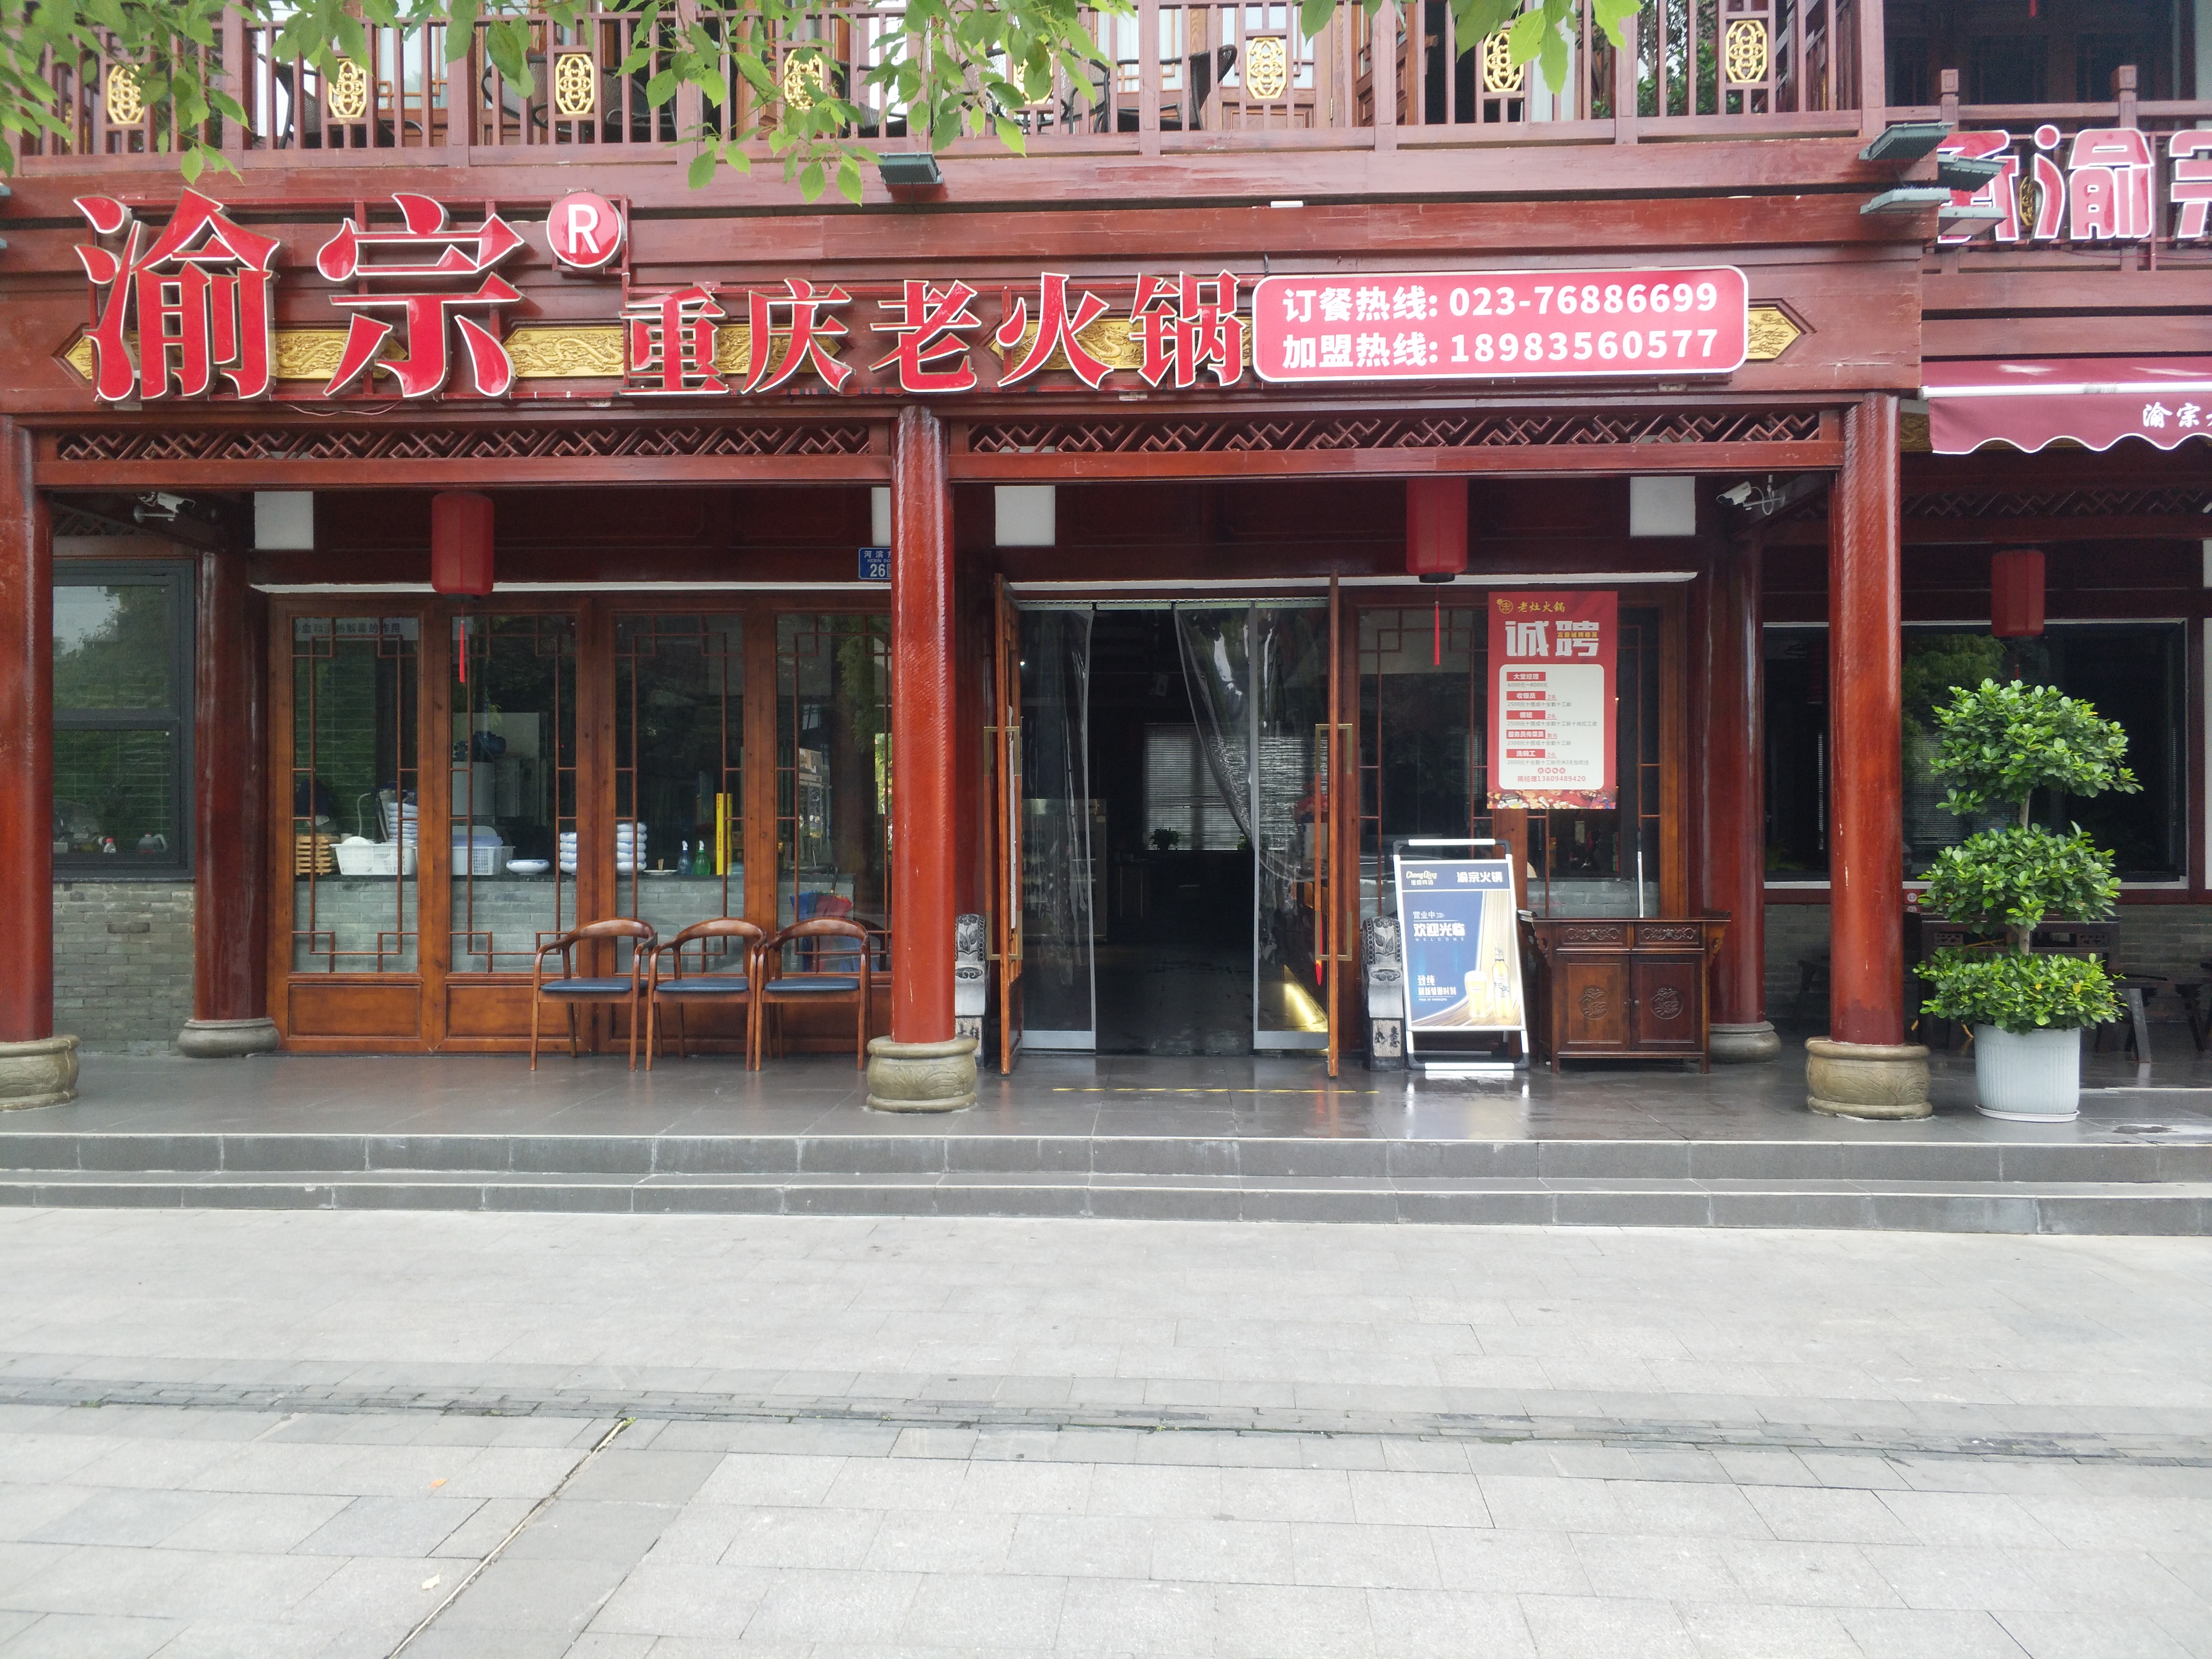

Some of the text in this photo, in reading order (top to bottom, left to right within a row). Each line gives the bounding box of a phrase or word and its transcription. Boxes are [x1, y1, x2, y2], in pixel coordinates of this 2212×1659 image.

[72, 186, 527, 402] 渝宗
[619, 269, 1247, 396] 重庆老火锅
[2142, 401, 2212, 428] 渝宗
[870, 563, 886, 577] 26
[1517, 601, 1565, 613] 老灶火锅
[1505, 620, 1599, 657] 诚聘
[1456, 871, 1503, 883] 渝宗火锅
[1413, 911, 1436, 919] 营业中
[1413, 923, 1466, 937] 欢迎光临
[1418, 974, 1435, 986] 致纯
